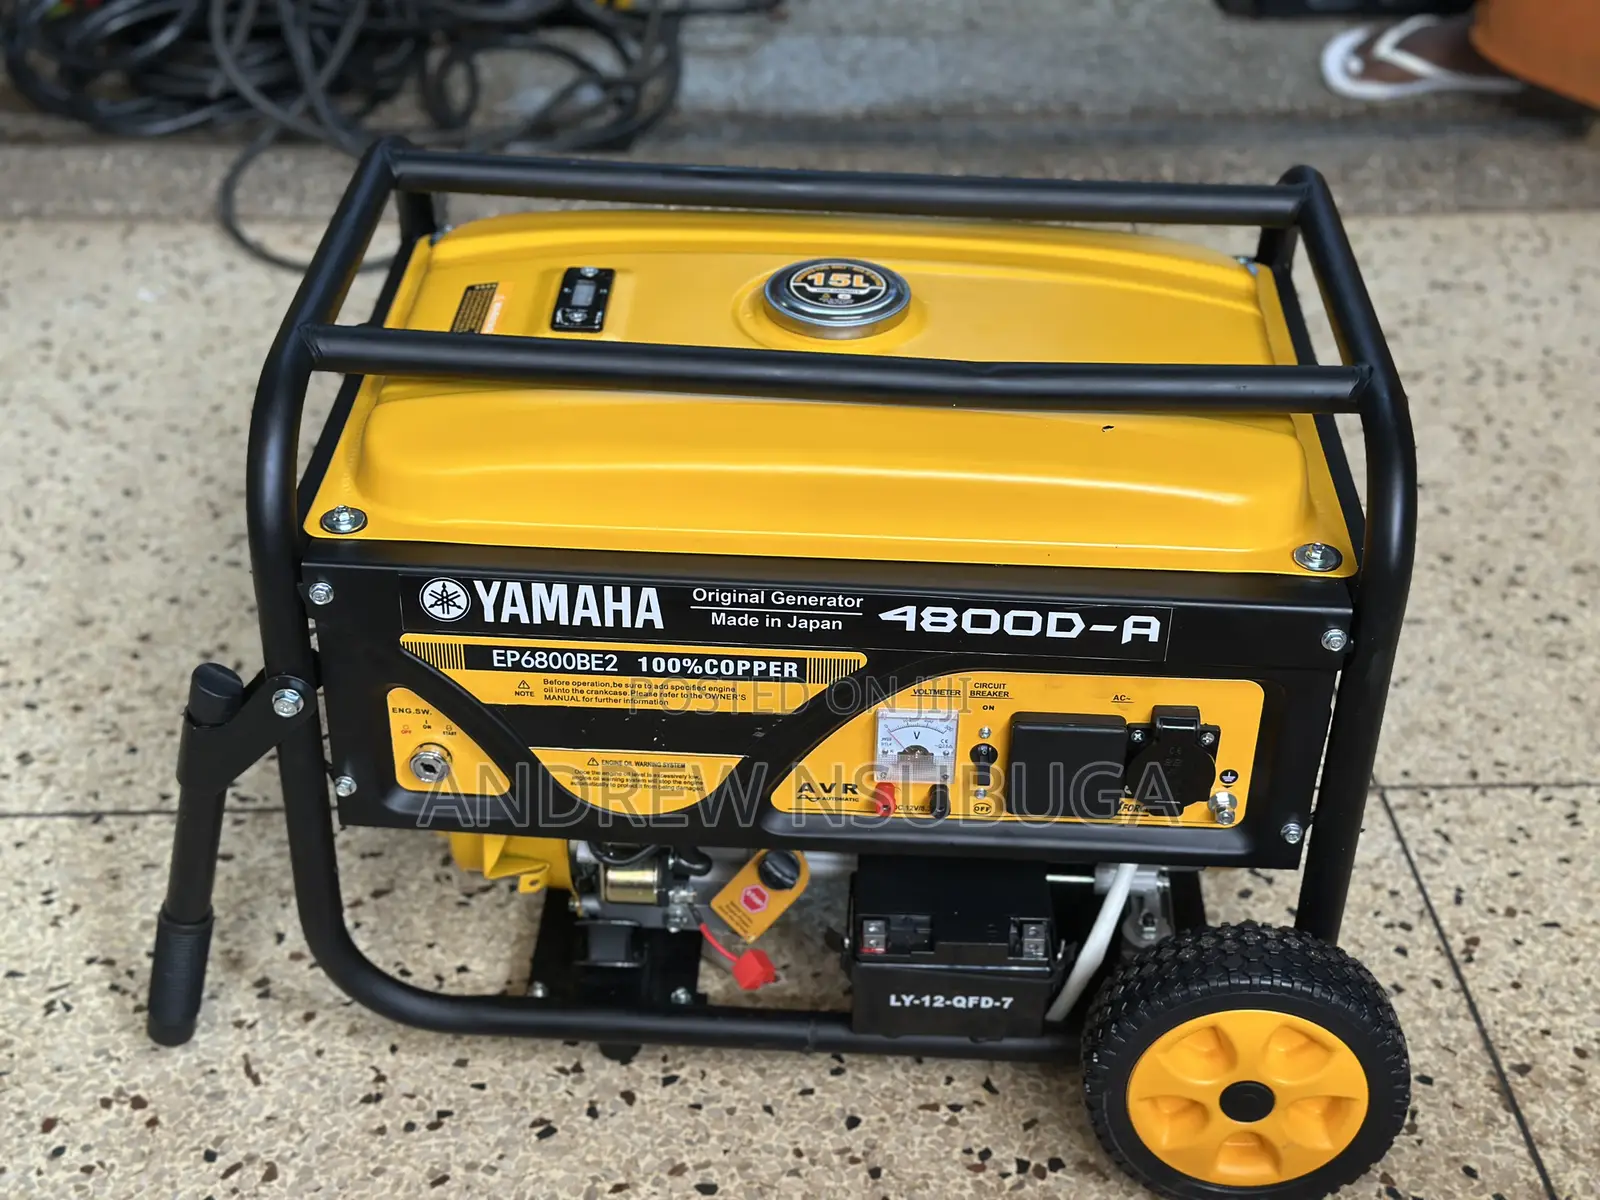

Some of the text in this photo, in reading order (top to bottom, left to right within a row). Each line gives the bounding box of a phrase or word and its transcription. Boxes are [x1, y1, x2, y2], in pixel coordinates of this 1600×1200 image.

[807, 272, 869, 287] 15L
[473, 580, 664, 630] YAMAHA
[692, 587, 864, 608] Original Generator
[712, 612, 843, 632] Made in Japan
[878, 605, 1160, 644] 4800D-A
[492, 649, 798, 678] EP6800BE2 100%COPPER
[543, 678, 570, 686] Before
[572, 680, 623, 688] operation,be
[670, 683, 706, 691] specified
[708, 685, 736, 693] engine
[913, 688, 961, 696] VOLTMETER
[974, 682, 1006, 690] CIRCUIT
[544, 694, 580, 702] MANUAL
[624, 697, 669, 705] information
[970, 690, 1010, 698] BREAKER
[392, 707, 432, 715] ENG.SW.
[913, 731, 920, 740] V
[798, 782, 859, 794] AVR
[889, 994, 1014, 1009] LY-12-QFD-7
